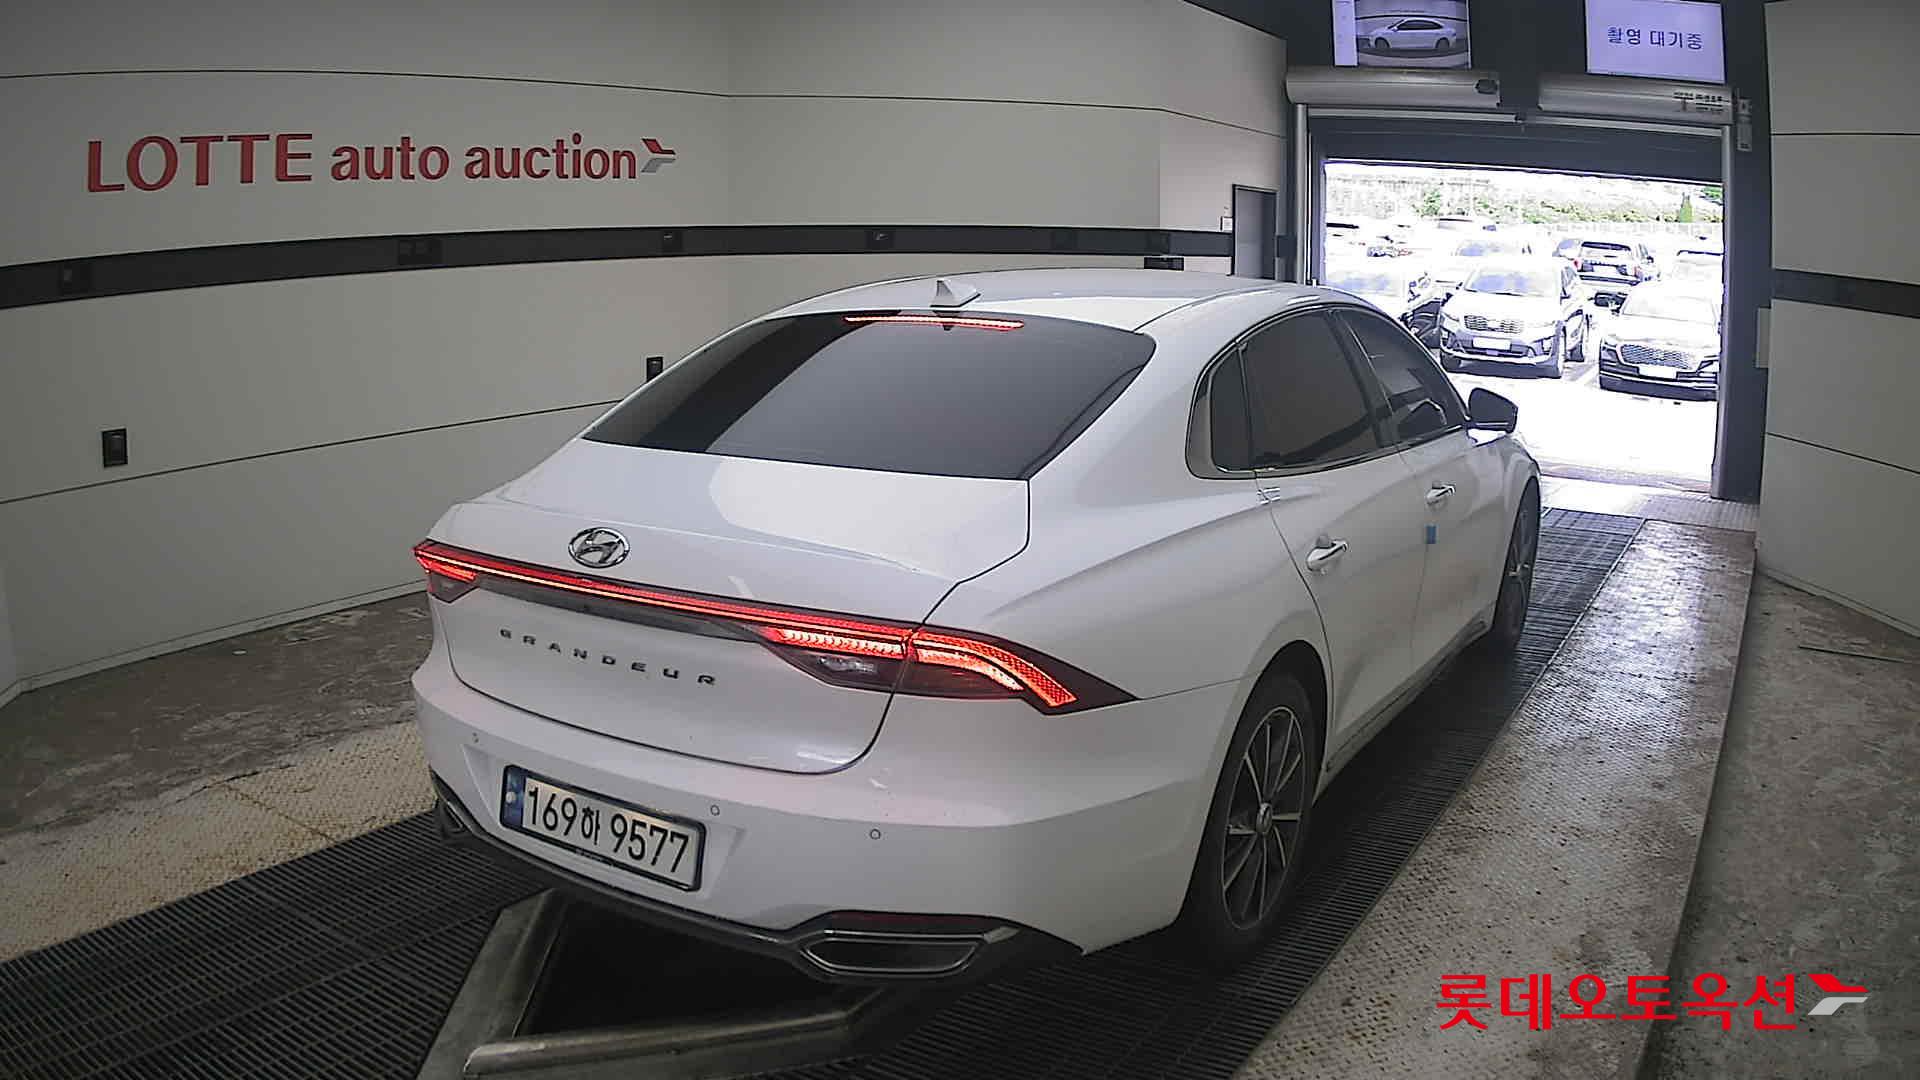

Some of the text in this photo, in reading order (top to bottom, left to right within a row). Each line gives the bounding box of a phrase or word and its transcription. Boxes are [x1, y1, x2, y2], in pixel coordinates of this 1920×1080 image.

[1649, 30, 1702, 50] 대기중
[87, 132, 638, 193] LOTTE auto auction
[499, 628, 717, 687] GRANDEUR
[610, 813, 690, 873] 9577
